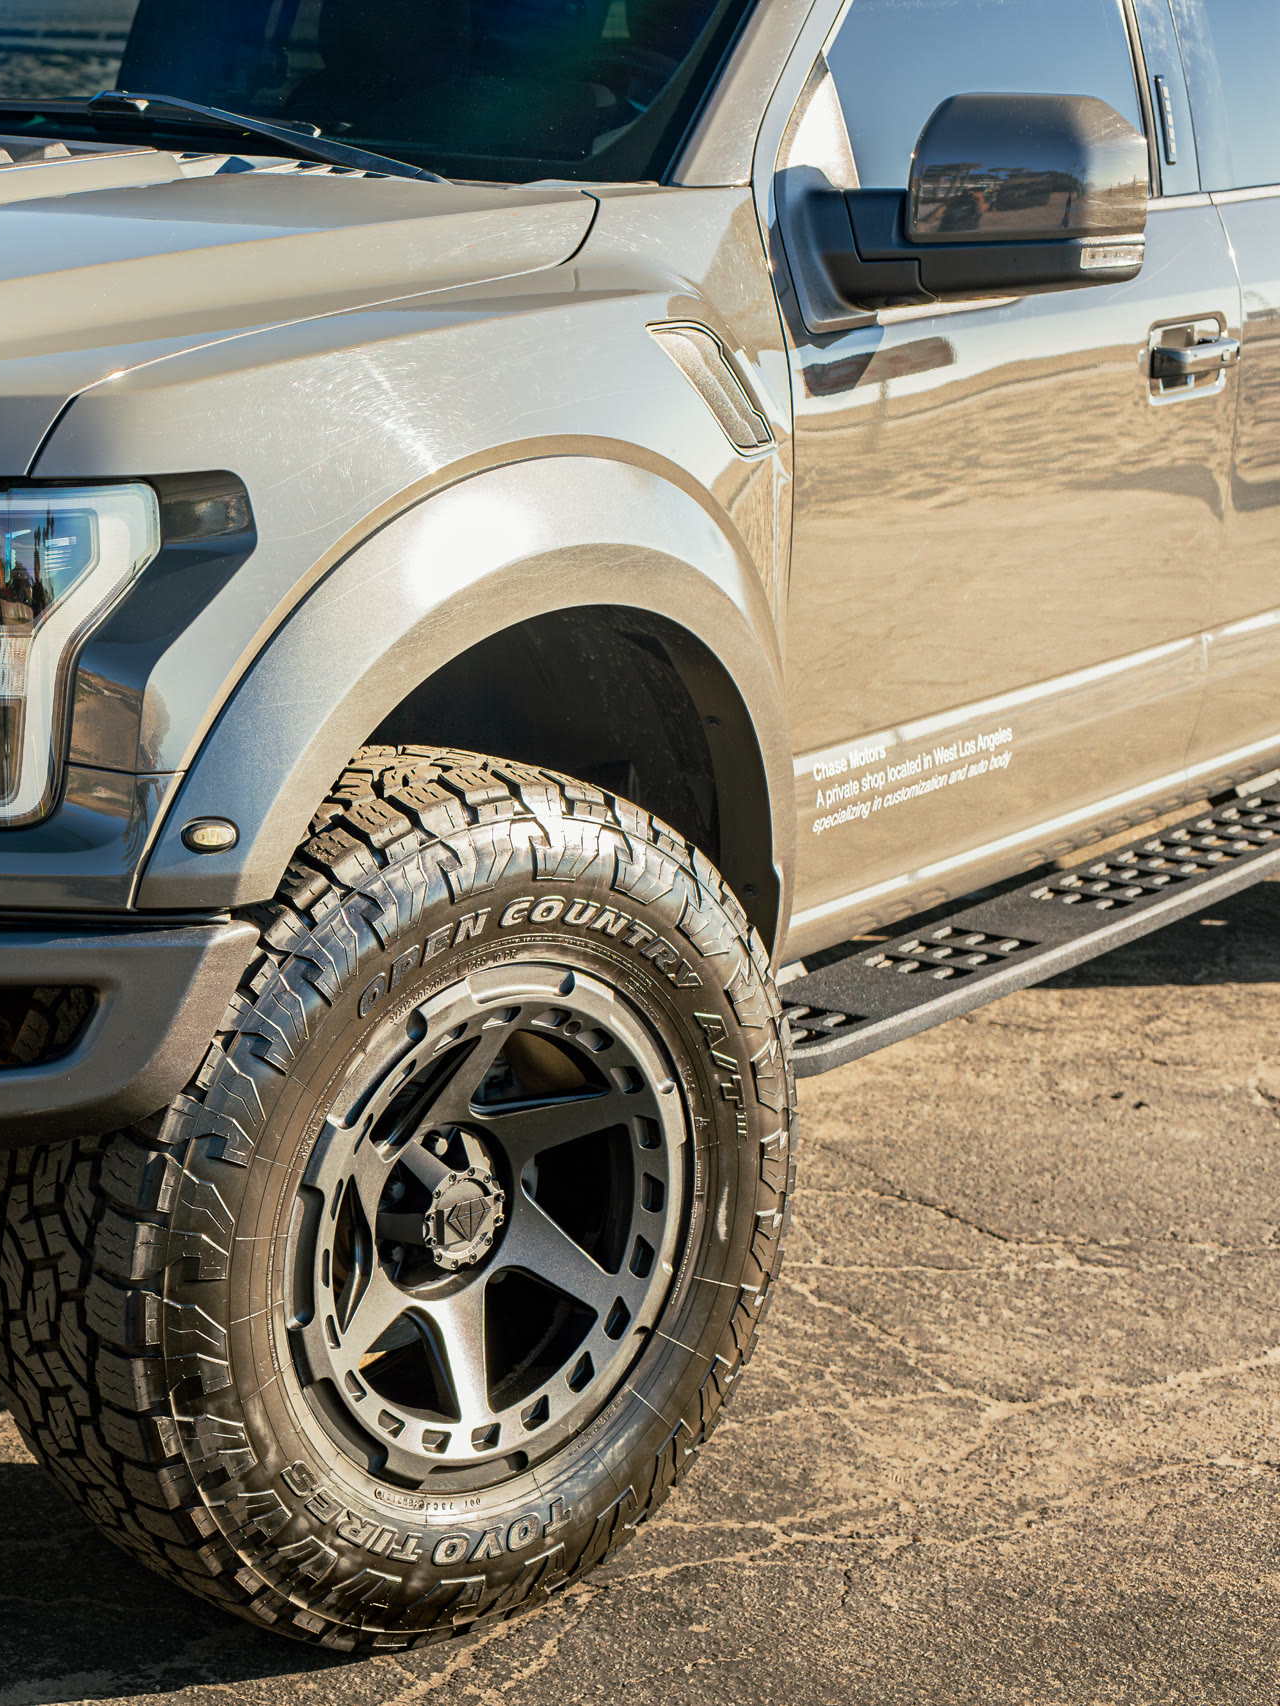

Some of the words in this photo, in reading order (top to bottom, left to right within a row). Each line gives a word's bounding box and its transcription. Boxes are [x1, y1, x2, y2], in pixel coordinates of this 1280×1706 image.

[812, 758, 848, 781] Chase
[848, 744, 886, 769] Motors
[812, 801, 871, 835] specializing
[872, 794, 883, 812] in
[883, 773, 948, 808] customization
[948, 763, 968, 785] and
[967, 758, 989, 778] auto
[988, 750, 1013, 770] body
[816, 788, 825, 809] A
[825, 780, 859, 809] private
[861, 771, 885, 790] shop
[886, 754, 921, 783] located
[922, 752, 932, 770] in
[933, 743, 958, 766] West
[958, 740, 976, 758] Los
[977, 727, 1013, 752] Angeles
[358, 907, 492, 1019] OPEN
[498, 895, 702, 989] COUNTRY
[279, 1459, 423, 1565] TIRES
[430, 1495, 573, 1566] TOYO
